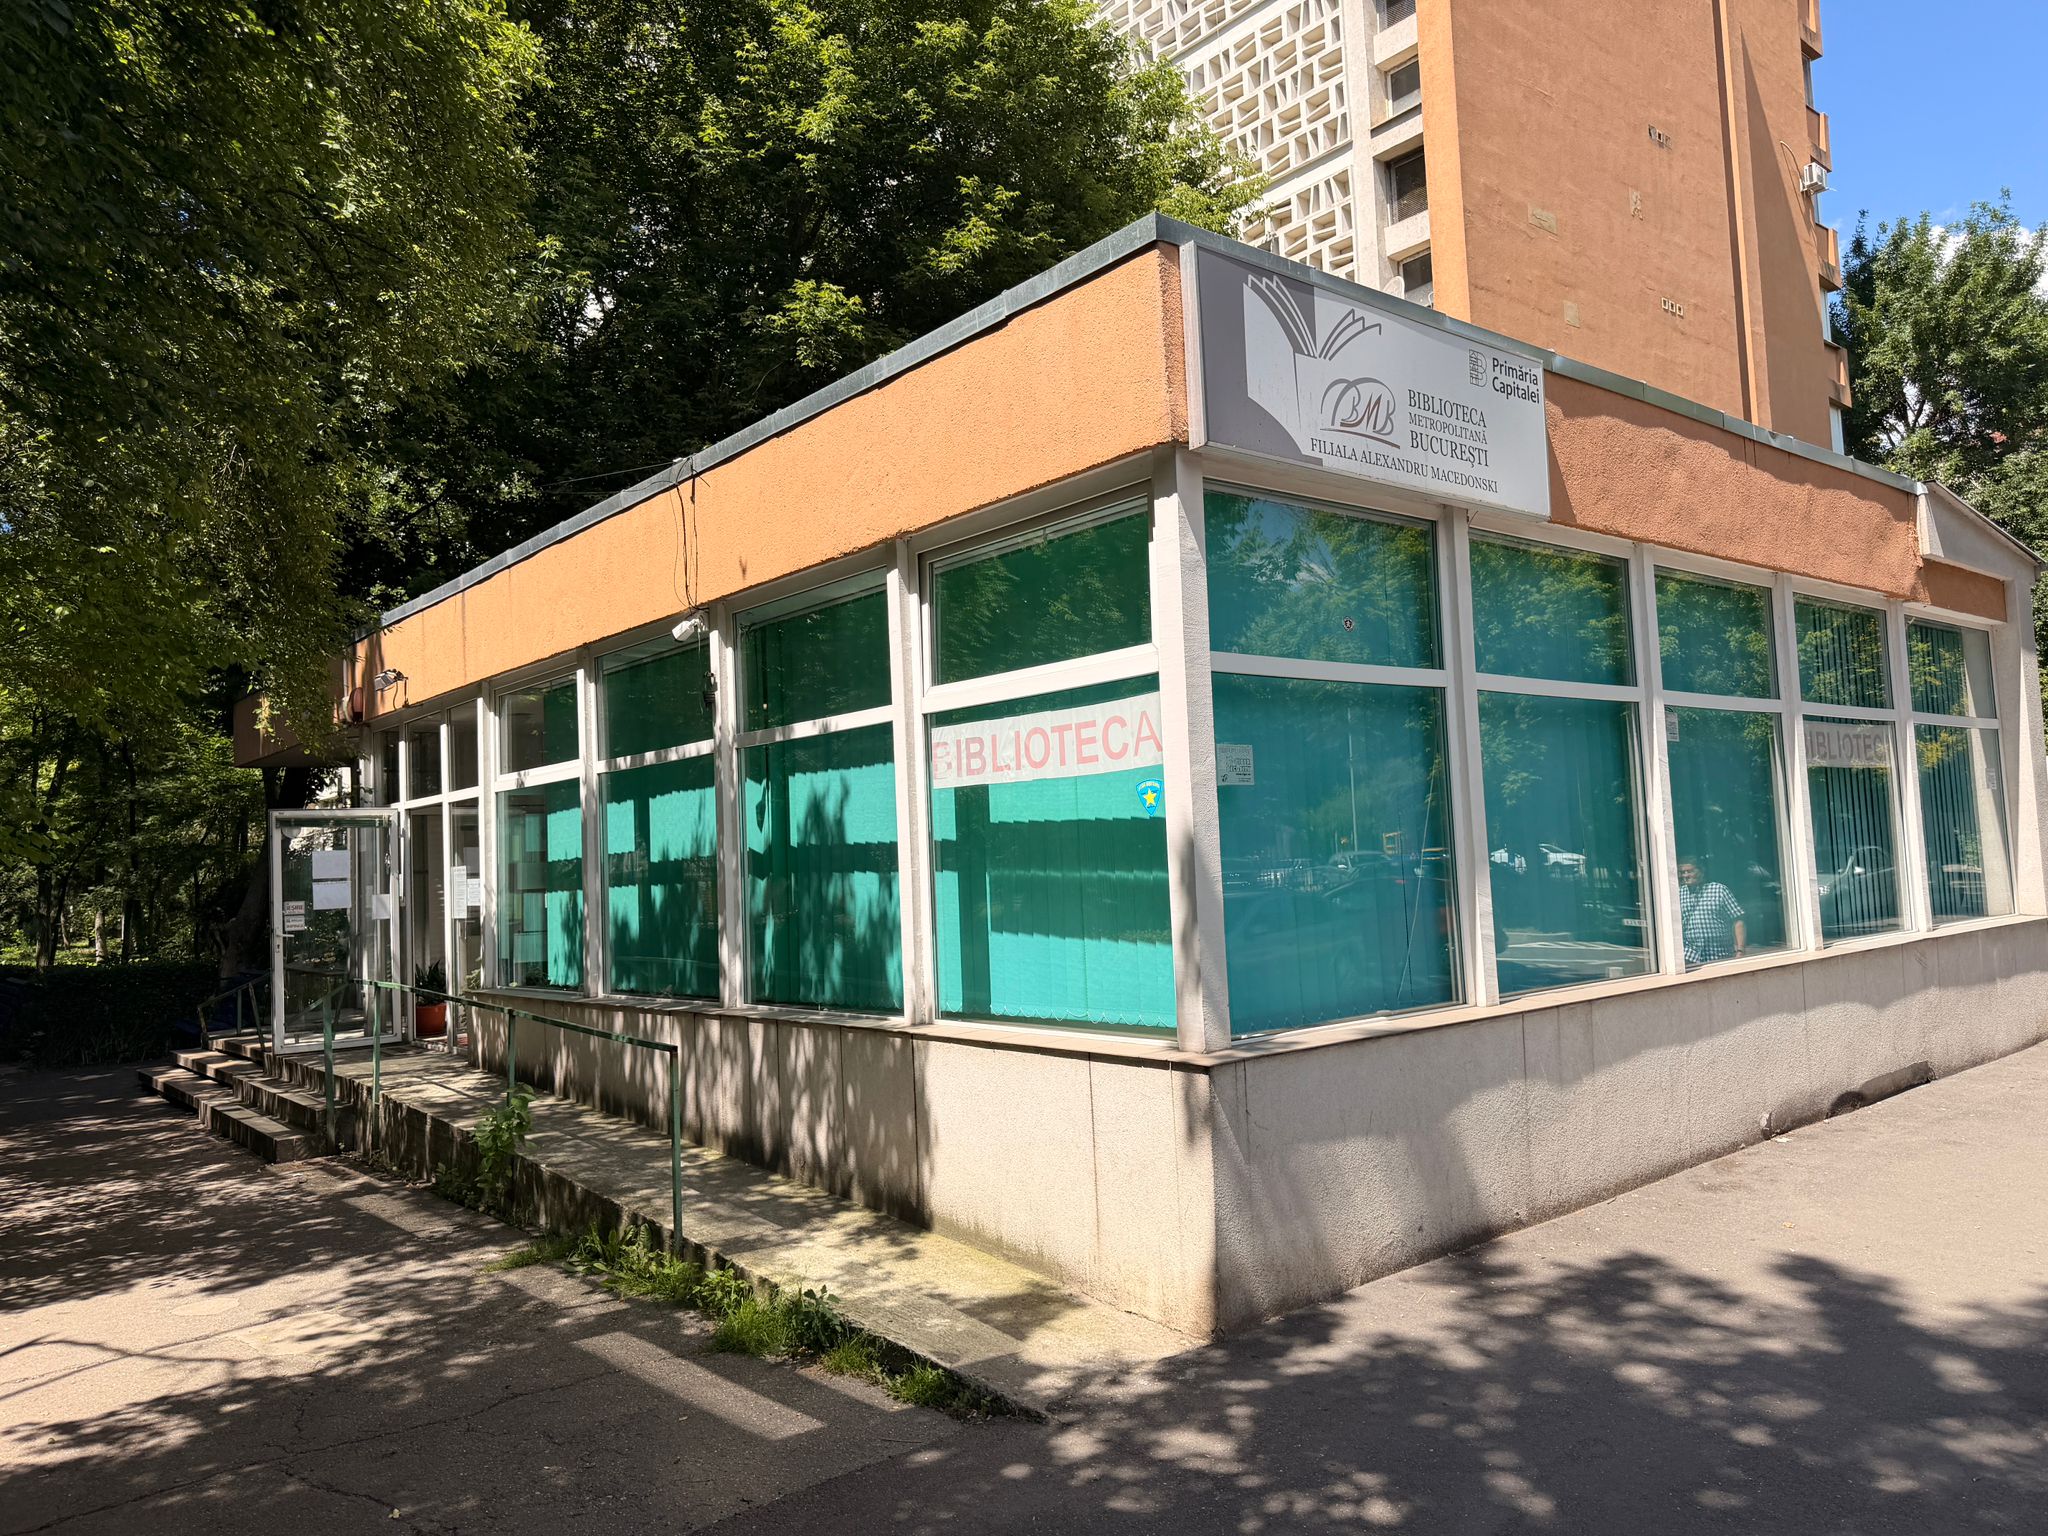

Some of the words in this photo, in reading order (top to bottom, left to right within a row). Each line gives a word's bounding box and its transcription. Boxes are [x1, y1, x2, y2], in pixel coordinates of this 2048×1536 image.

[1492, 357, 1538, 386] Primăria
[1492, 376, 1540, 404] Capitalei
[1408, 388, 1487, 428] BIBLIOTECA
[1408, 411, 1488, 445] METROPOLITANĂ
[1310, 437, 1358, 462] FILIALA
[1360, 449, 1428, 478] ALEXANDRU
[1430, 465, 1498, 494] MACEDONSKI
[932, 710, 1163, 780] BIBLIOTECA
